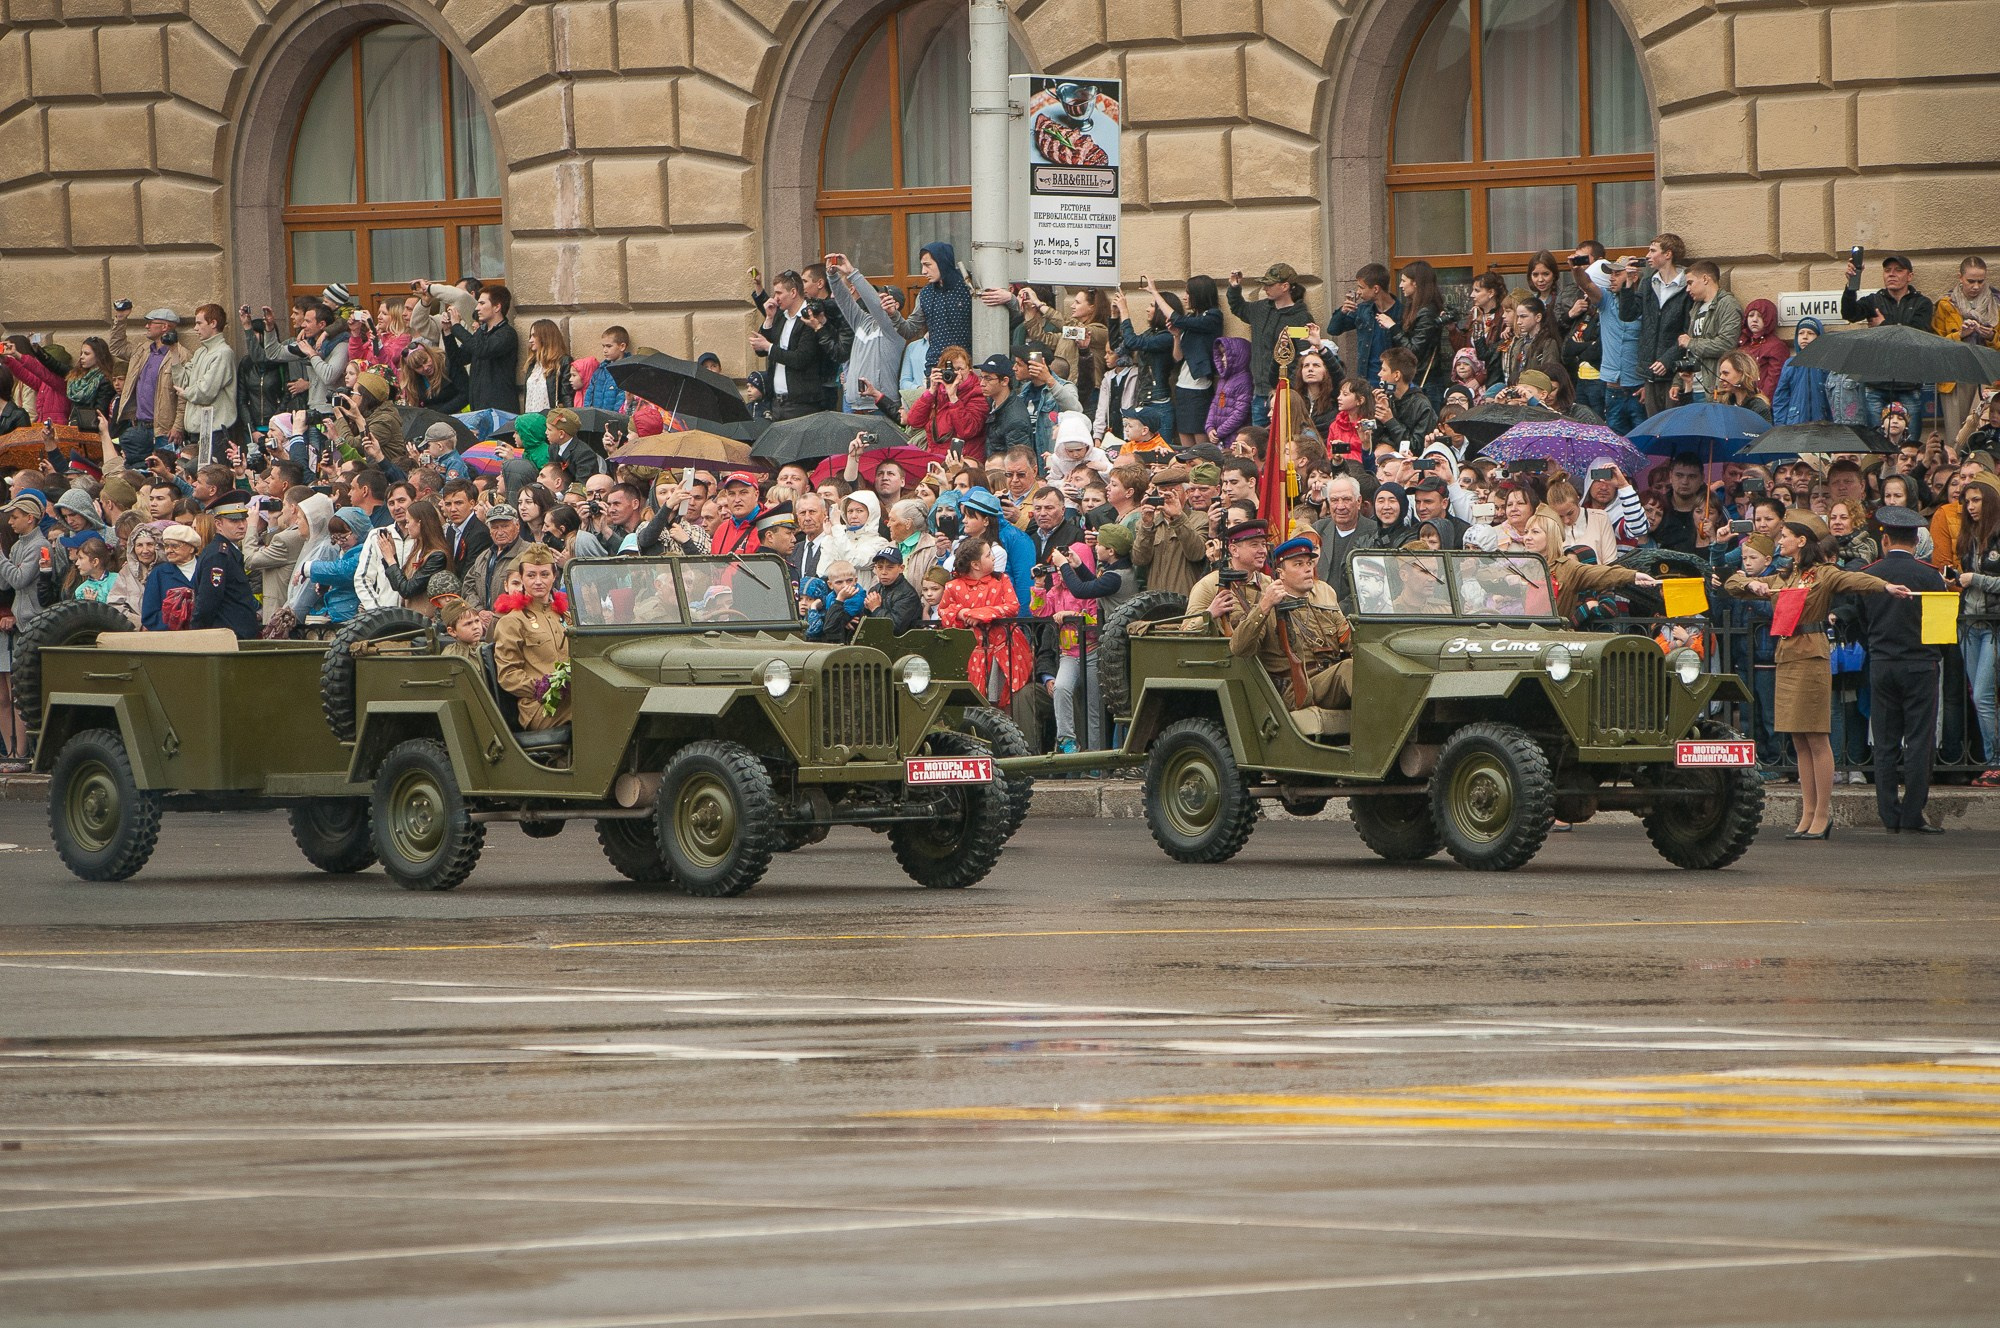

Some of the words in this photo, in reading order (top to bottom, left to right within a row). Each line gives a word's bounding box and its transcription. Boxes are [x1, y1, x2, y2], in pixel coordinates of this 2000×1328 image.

[1052, 173, 1099, 186] BAR&GRILL
[1060, 203, 1091, 212] РЕСТОРАН
[1033, 211, 1088, 221] ПЕРВОКЛАССНЫХ
[1089, 213, 1117, 222] СТЕЙКОВ
[1033, 239, 1046, 248] ул.
[1048, 238, 1072, 248] Мира,
[1074, 238, 1079, 247] 5
[1033, 257, 1062, 266] 55-10-50
[1800, 301, 1838, 315] МИРА
[1448, 638, 1482, 653] За
[1692, 745, 1730, 754] МОТОРЫ
[1681, 753, 1740, 763] СТАЛИНГРАДА
[923, 761, 963, 771] МОТОРЫ
[912, 769, 975, 780] СТАЛИНГРАДА
